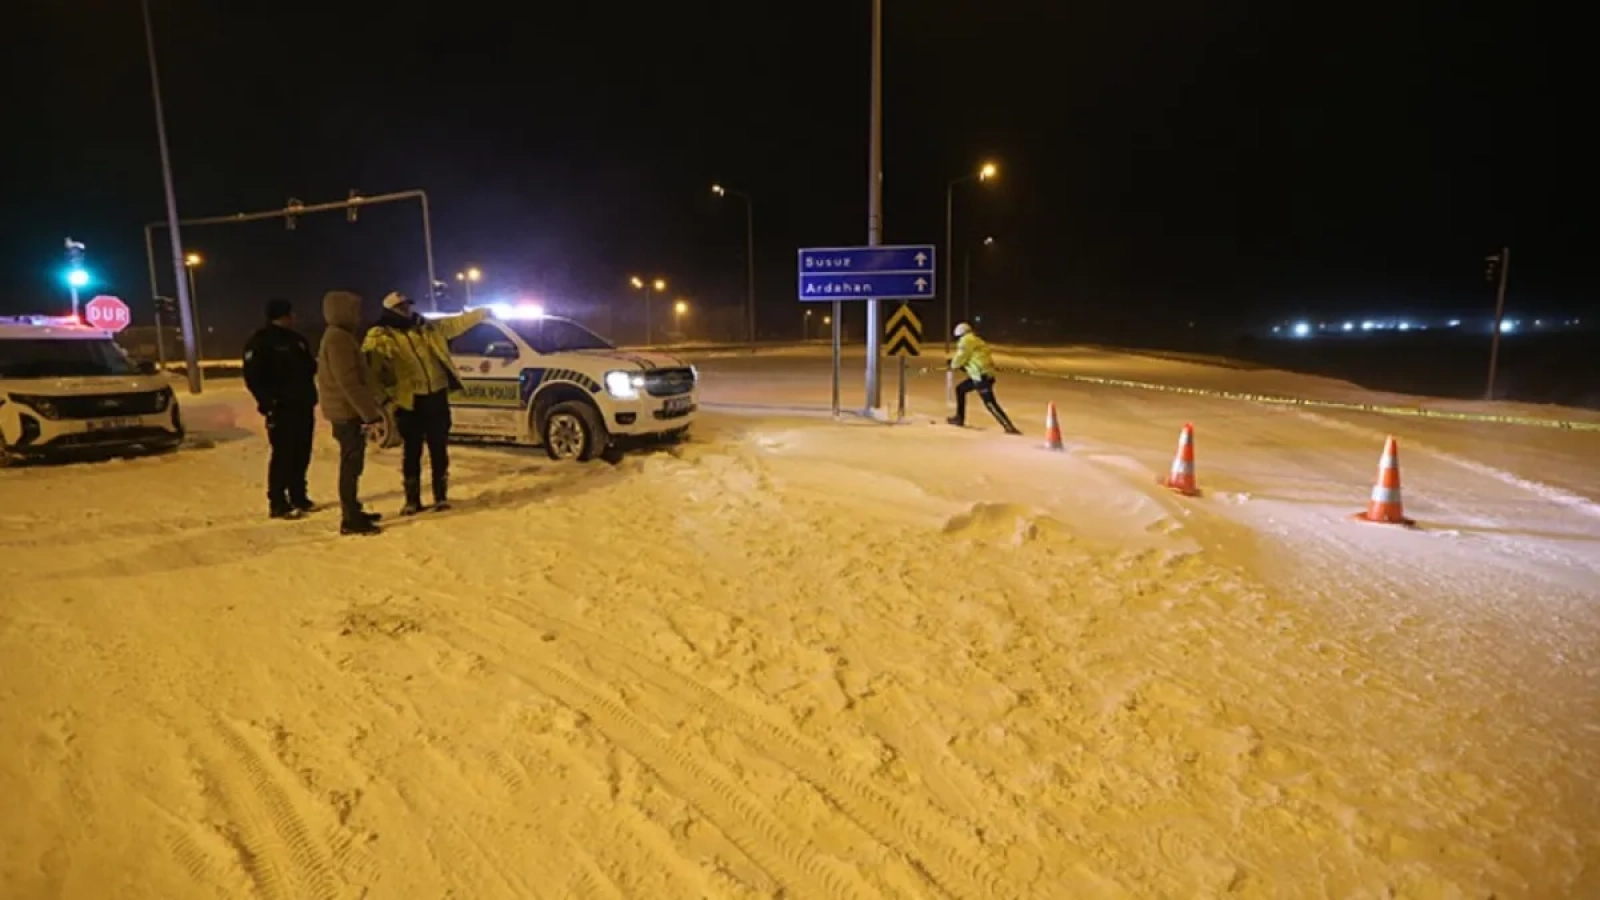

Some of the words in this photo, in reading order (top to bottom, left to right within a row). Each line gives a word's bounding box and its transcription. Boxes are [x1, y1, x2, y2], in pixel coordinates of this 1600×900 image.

[806, 256, 851, 267] Susuz
[806, 283, 873, 293] Ardahan
[91, 306, 126, 321] DUR
